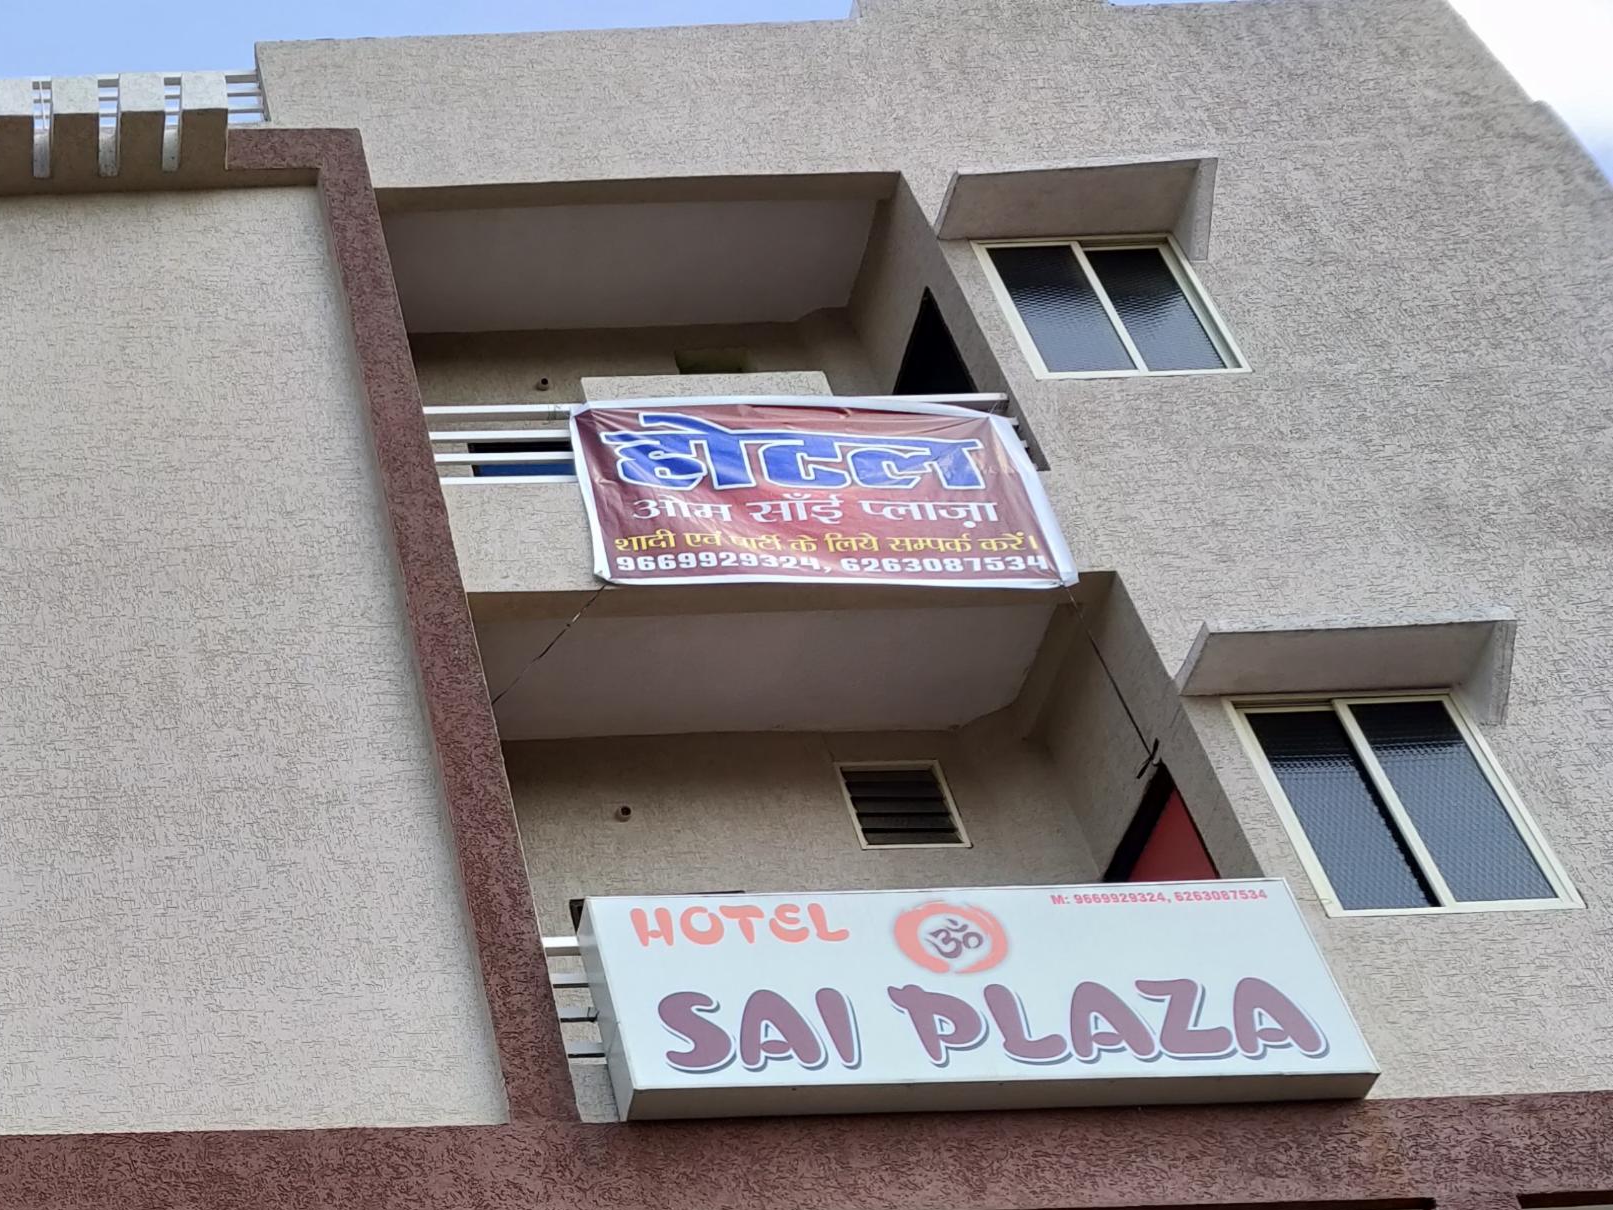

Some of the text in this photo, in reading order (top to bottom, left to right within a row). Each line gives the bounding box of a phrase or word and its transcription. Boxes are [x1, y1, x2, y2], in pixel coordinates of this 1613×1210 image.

[601, 412, 984, 490] होटल
[633, 495, 732, 522] ओम
[858, 501, 998, 528] प्लाज़ा
[614, 528, 676, 552] शादी
[683, 530, 723, 547] एवं
[728, 533, 782, 551] पार्टी
[788, 535, 818, 553] के
[824, 532, 878, 553] लिये
[888, 532, 971, 553] सम्पर्क
[616, 552, 1049, 574] 9669929324, 6263087534
[1073, 891, 1171, 905] 9669929324,
[1174, 889, 1268, 902] 6263087534
[630, 904, 850, 947] HOTEL
[658, 977, 1331, 1074] SAI PLAZA
